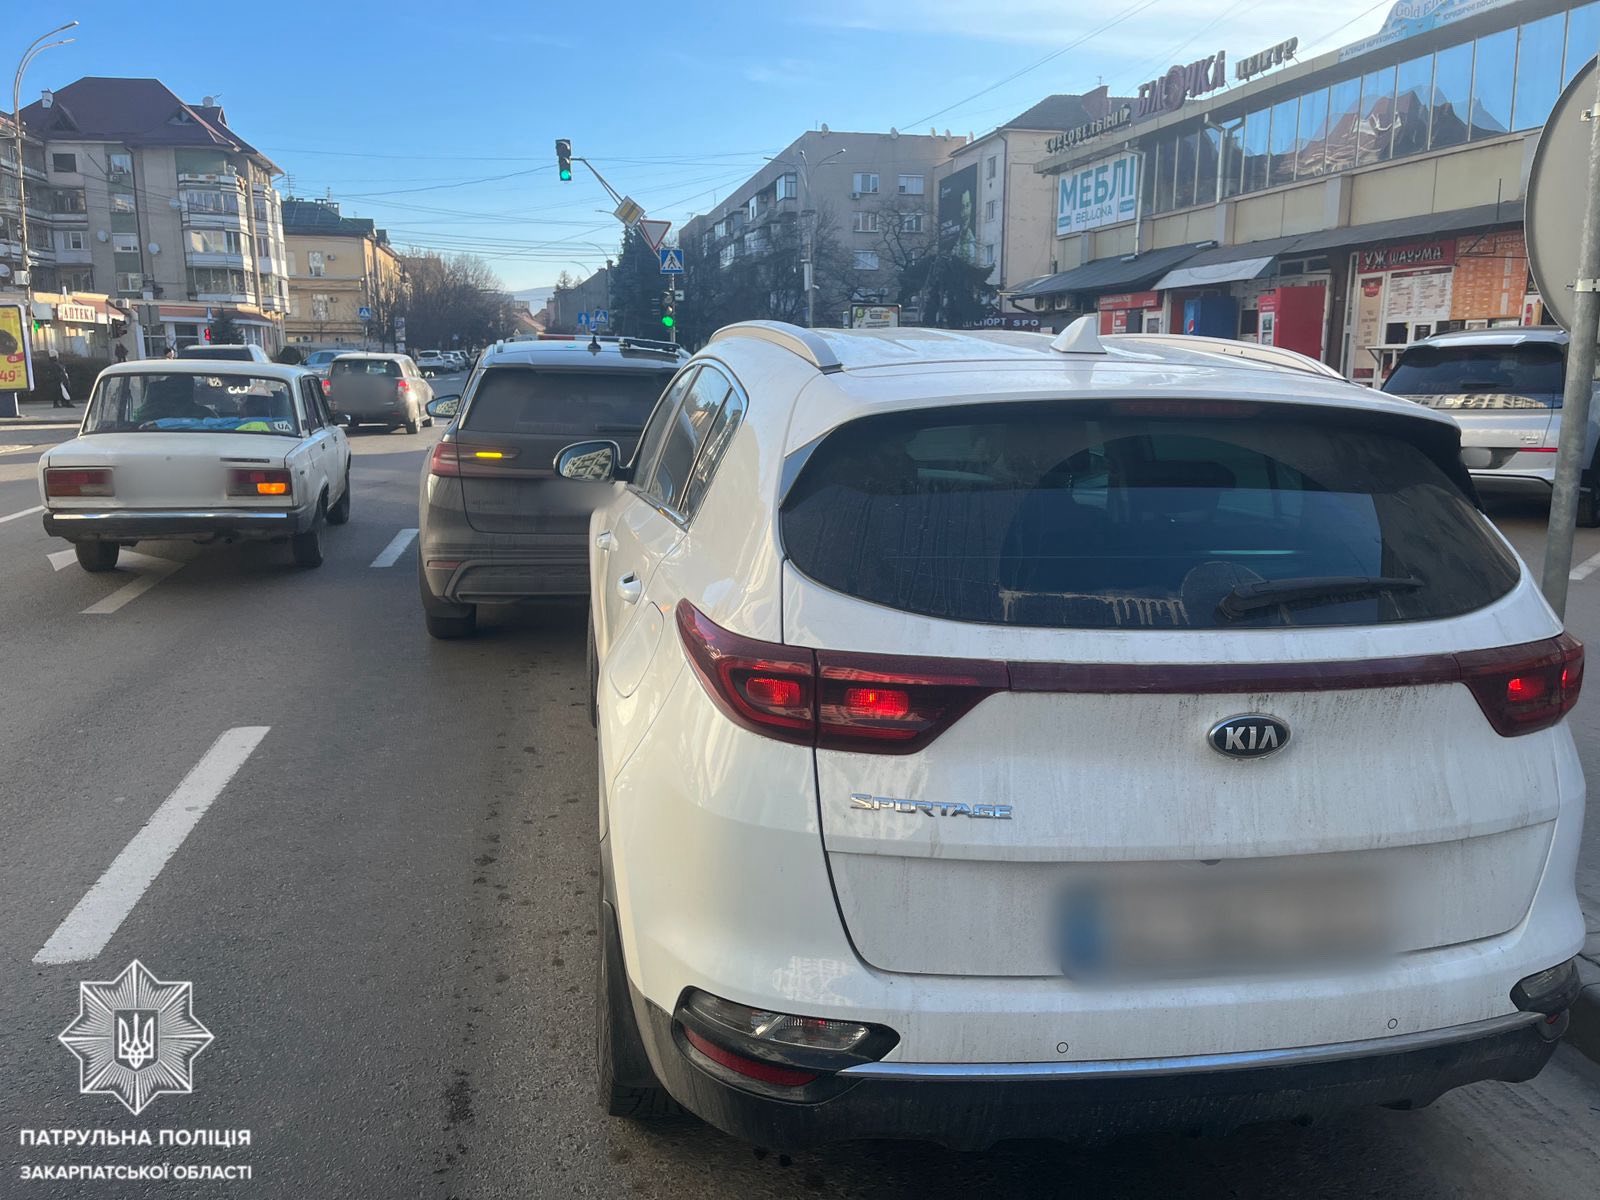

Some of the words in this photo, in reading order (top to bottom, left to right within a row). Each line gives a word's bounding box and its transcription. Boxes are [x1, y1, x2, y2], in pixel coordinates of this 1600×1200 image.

[1395, 3, 1420, 18] Gold
[1235, 36, 1299, 81] ЦЕНТР
[1060, 156, 1136, 213] МЕБЛІ
[1075, 205, 1113, 224] BELLONA
[1390, 247, 1442, 265] ШАУРМА
[63, 306, 95, 321] АПТЕКА
[277, 423, 291, 431] UA
[1225, 725, 1278, 751] KIA
[850, 793, 1014, 820] SPORTAGE
